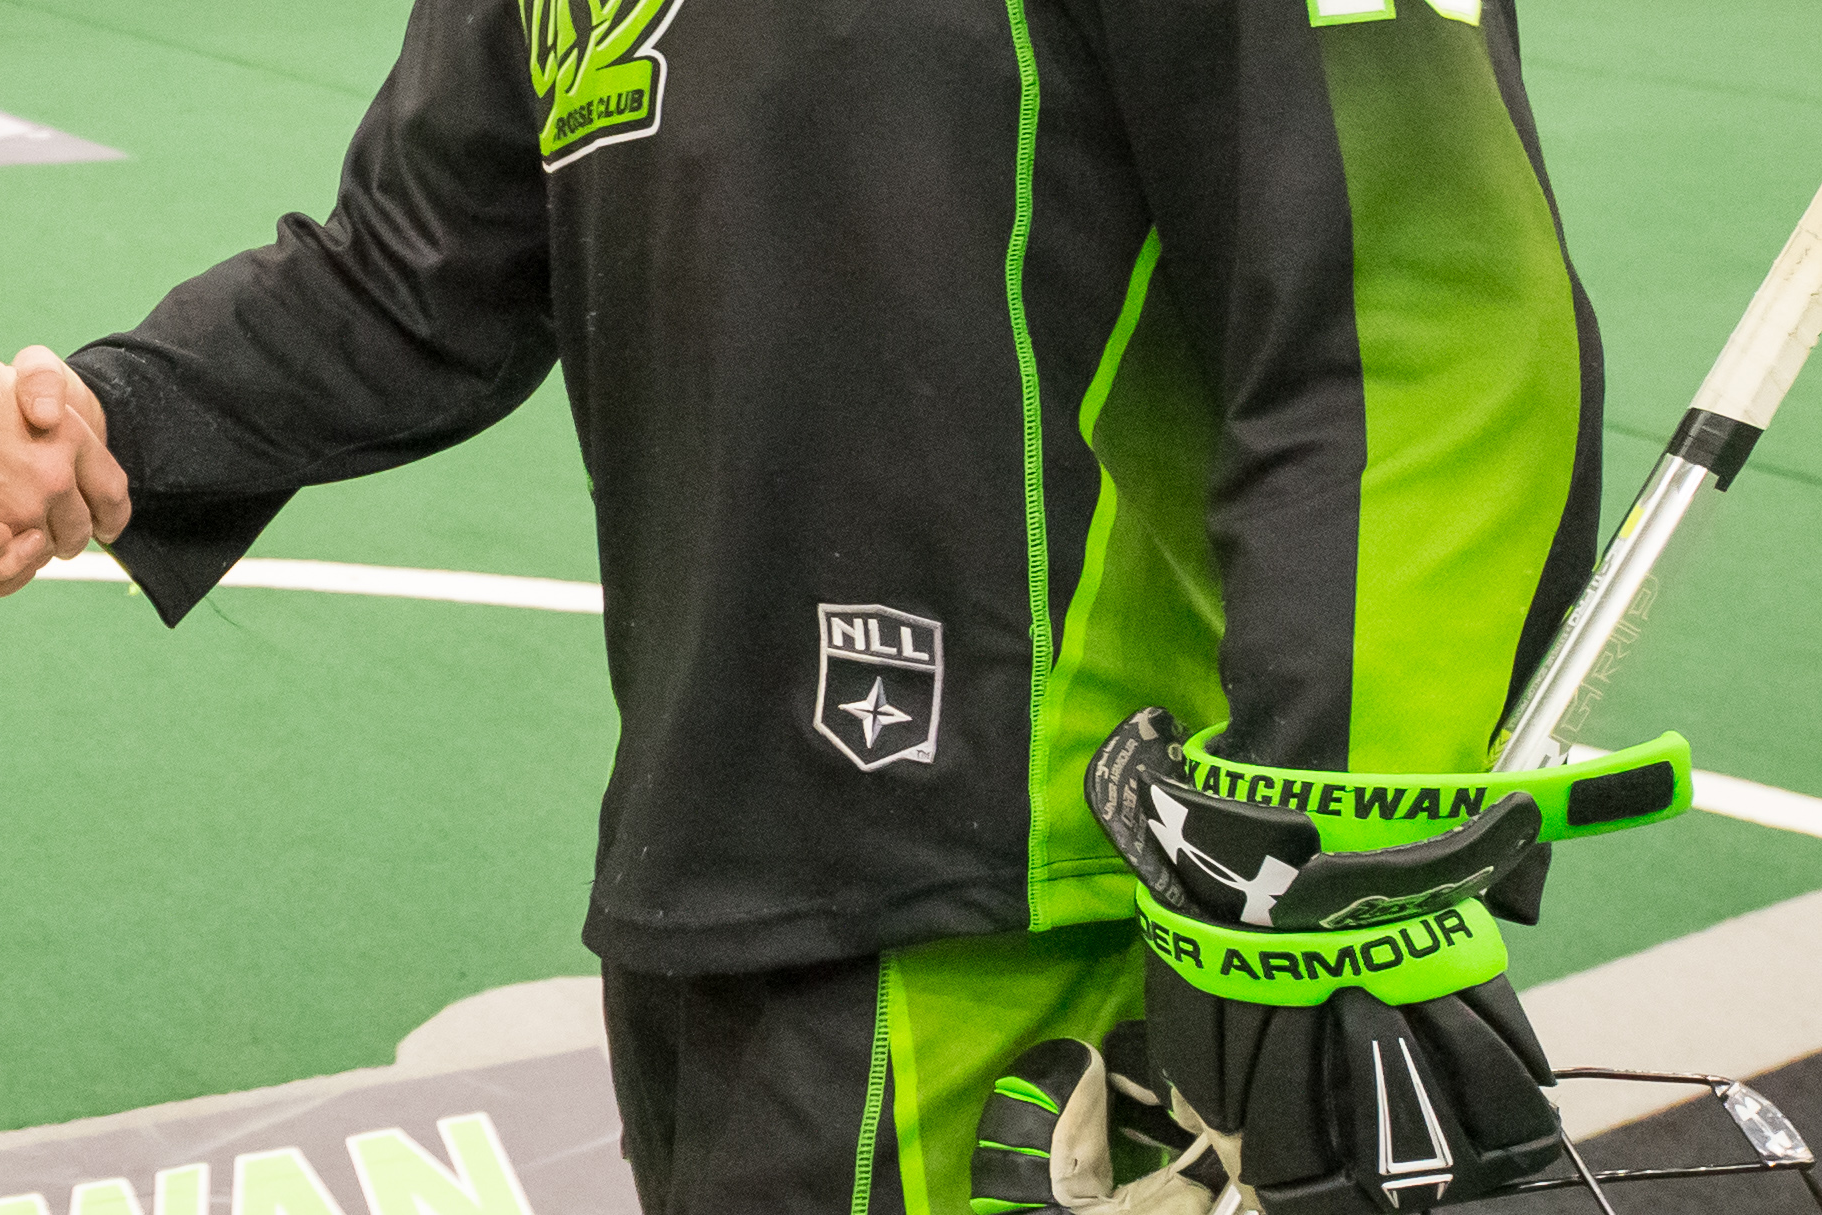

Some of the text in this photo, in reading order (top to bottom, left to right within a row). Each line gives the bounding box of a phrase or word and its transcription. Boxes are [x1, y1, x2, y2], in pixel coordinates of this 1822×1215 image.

[597, 89, 645, 121] CLUB
[830, 616, 930, 662] NLL
[1180, 756, 1488, 821] KATCHEWAN
[1220, 908, 1474, 981] ARMOUR
